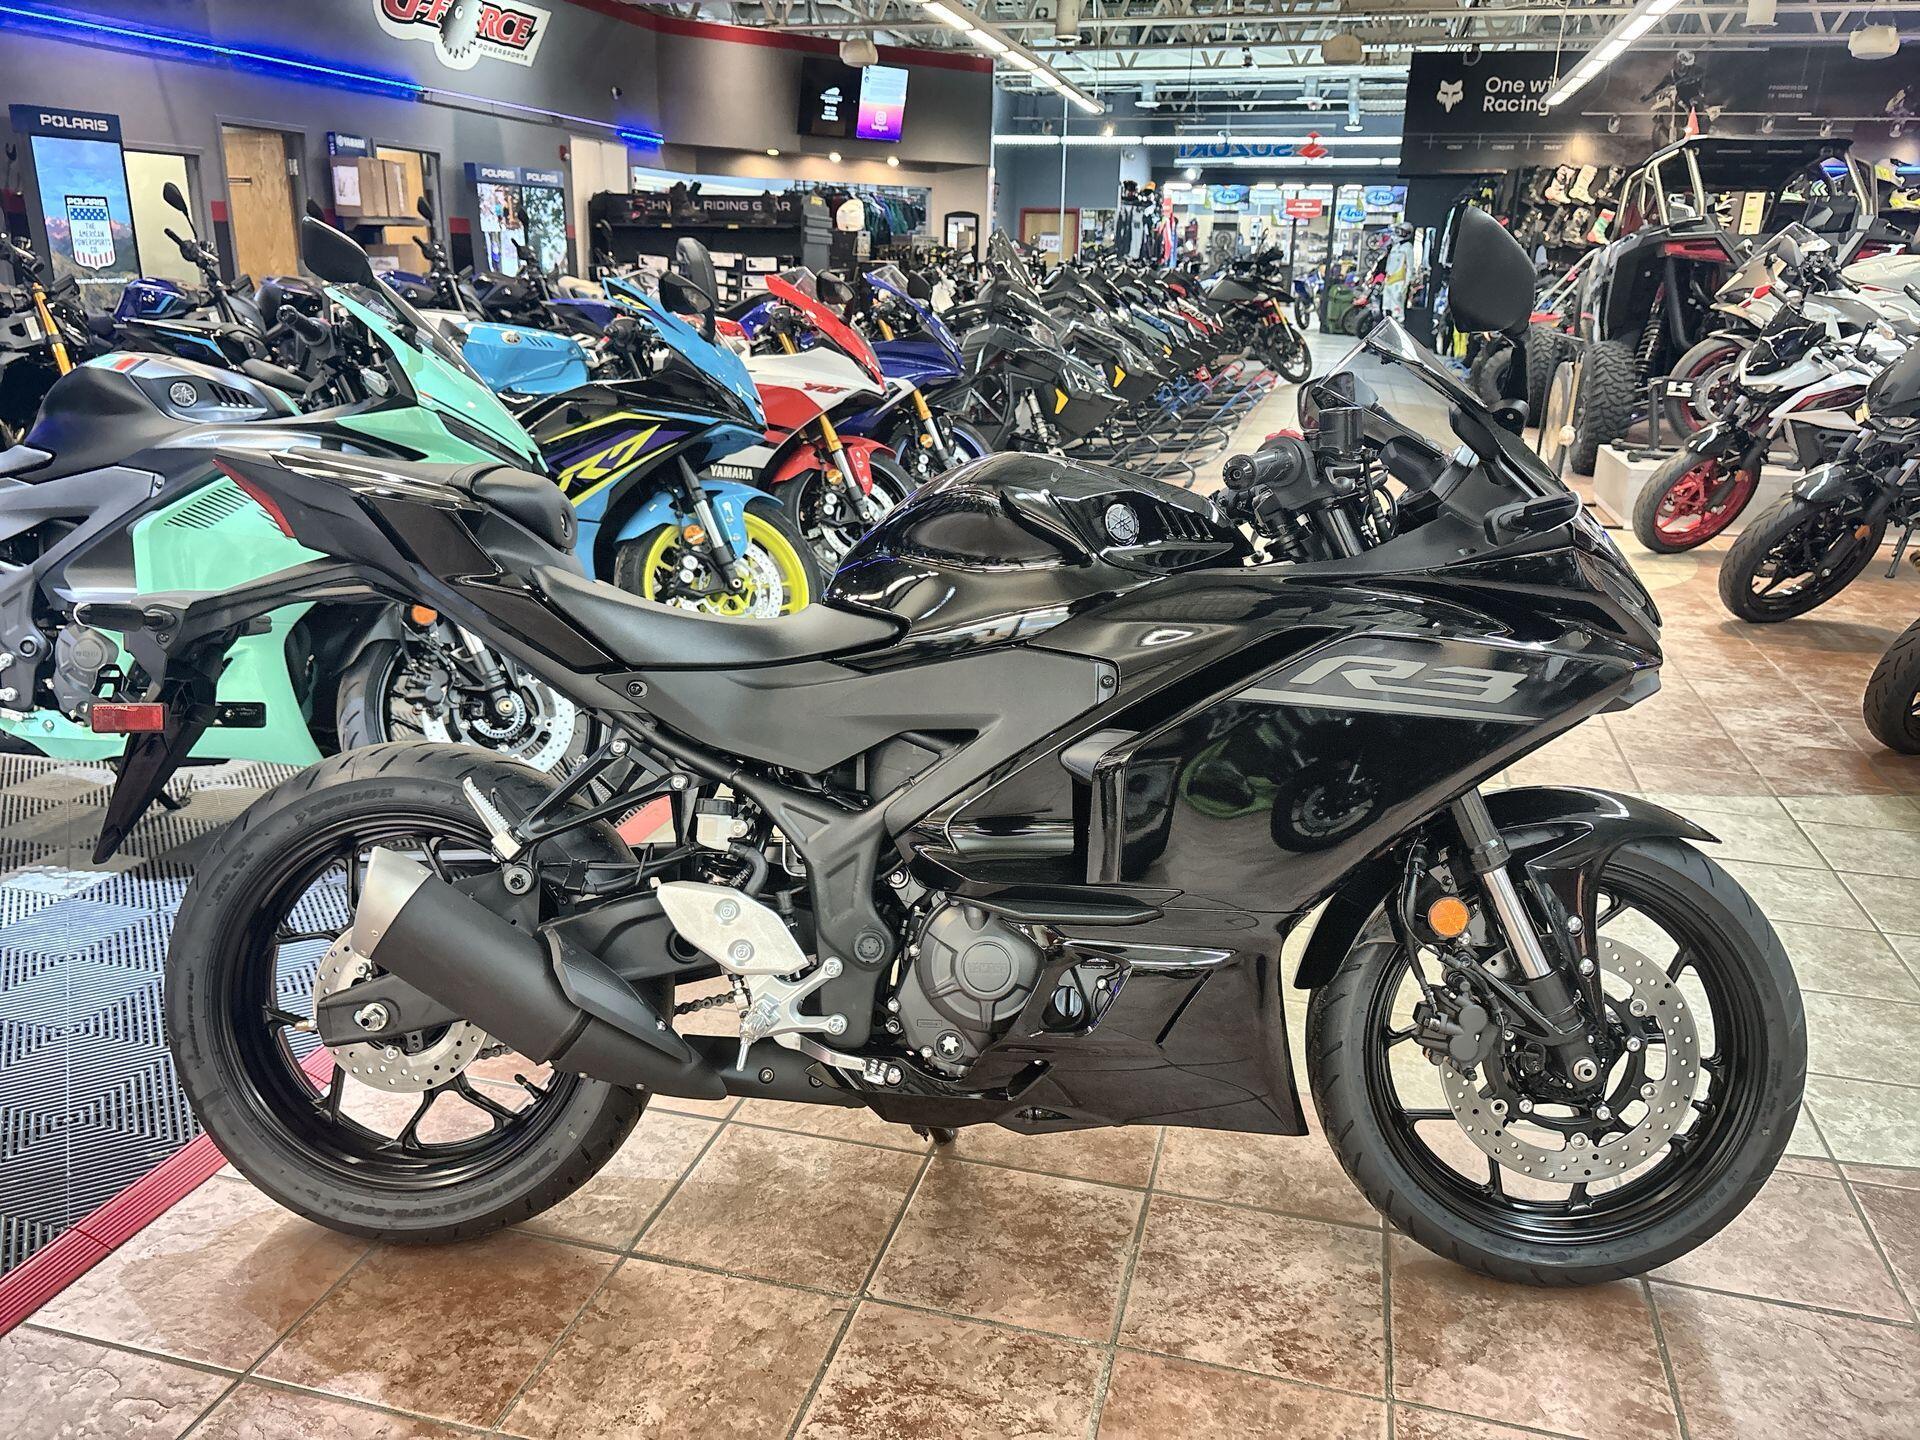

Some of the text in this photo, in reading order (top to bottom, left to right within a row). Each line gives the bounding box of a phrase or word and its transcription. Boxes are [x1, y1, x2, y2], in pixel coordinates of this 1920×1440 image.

[1485, 74, 1560, 93] One wi
[1482, 94, 1550, 116] Racing
[39, 113, 109, 132] POLARIS
[481, 167, 516, 180] POLARIS
[526, 172, 559, 183] POLARIS
[66, 197, 107, 206] POLARIS
[626, 200, 791, 212] TCHNL RIDING GR
[709, 464, 754, 481] YAMAHA
[1289, 655, 1529, 704] R3
